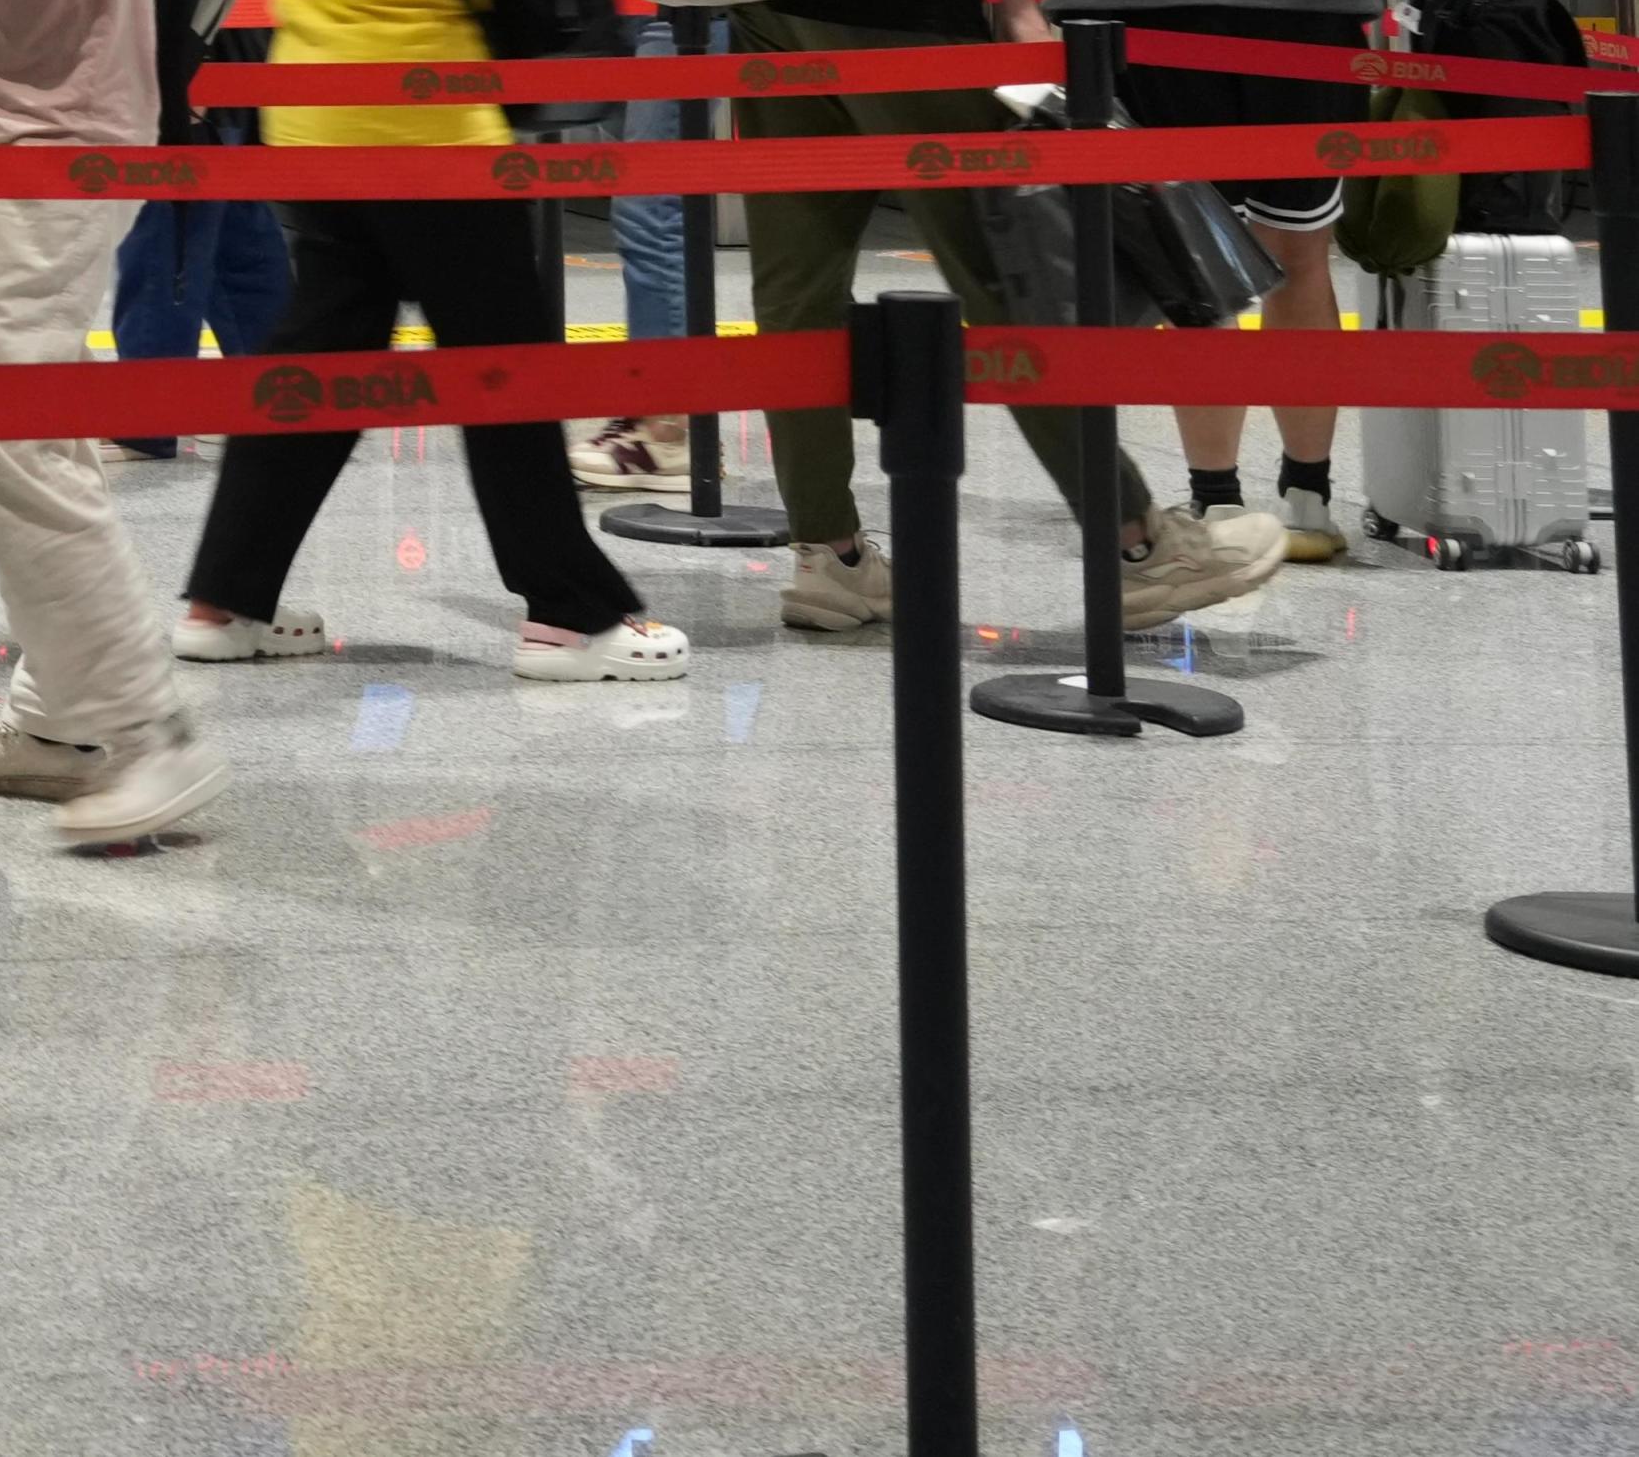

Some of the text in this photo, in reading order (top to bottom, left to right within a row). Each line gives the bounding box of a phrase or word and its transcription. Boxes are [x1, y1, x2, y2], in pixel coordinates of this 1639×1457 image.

[1392, 59, 1447, 82] BDIA
[964, 348, 1041, 384] DIA
[332, 368, 440, 410] BDIA
